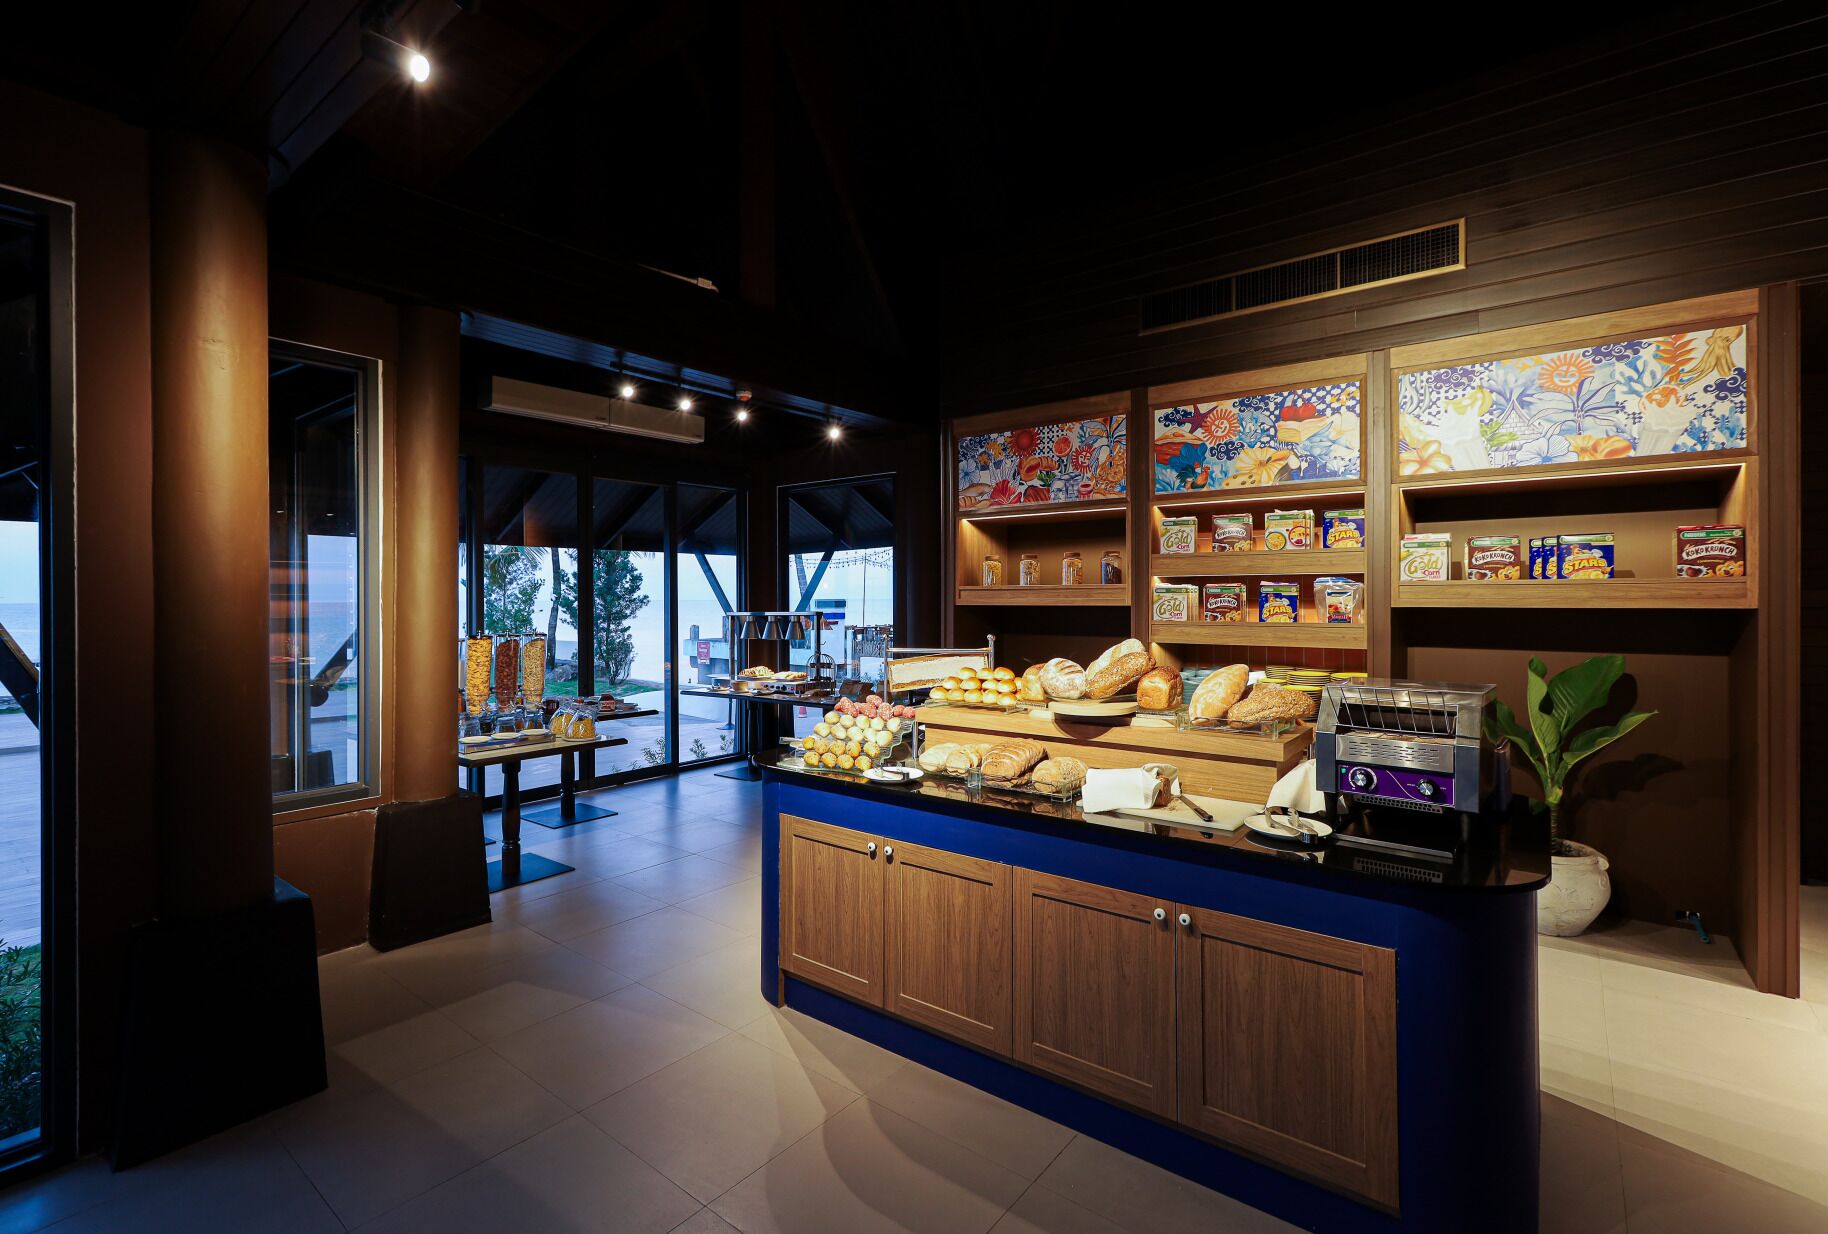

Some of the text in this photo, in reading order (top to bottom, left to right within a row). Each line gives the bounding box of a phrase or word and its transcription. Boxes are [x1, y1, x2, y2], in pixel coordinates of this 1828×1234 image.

[1165, 531, 1189, 549] Gold
[1328, 530, 1359, 544] STARS
[1490, 552, 1514, 561] KRUNCH
[1686, 545, 1735, 558] KOKO KRUNCH
[1408, 556, 1439, 574] Gold
[1563, 558, 1607, 576] STARS
[1159, 599, 1181, 615] Gold
[1262, 606, 1293, 618] STARS
